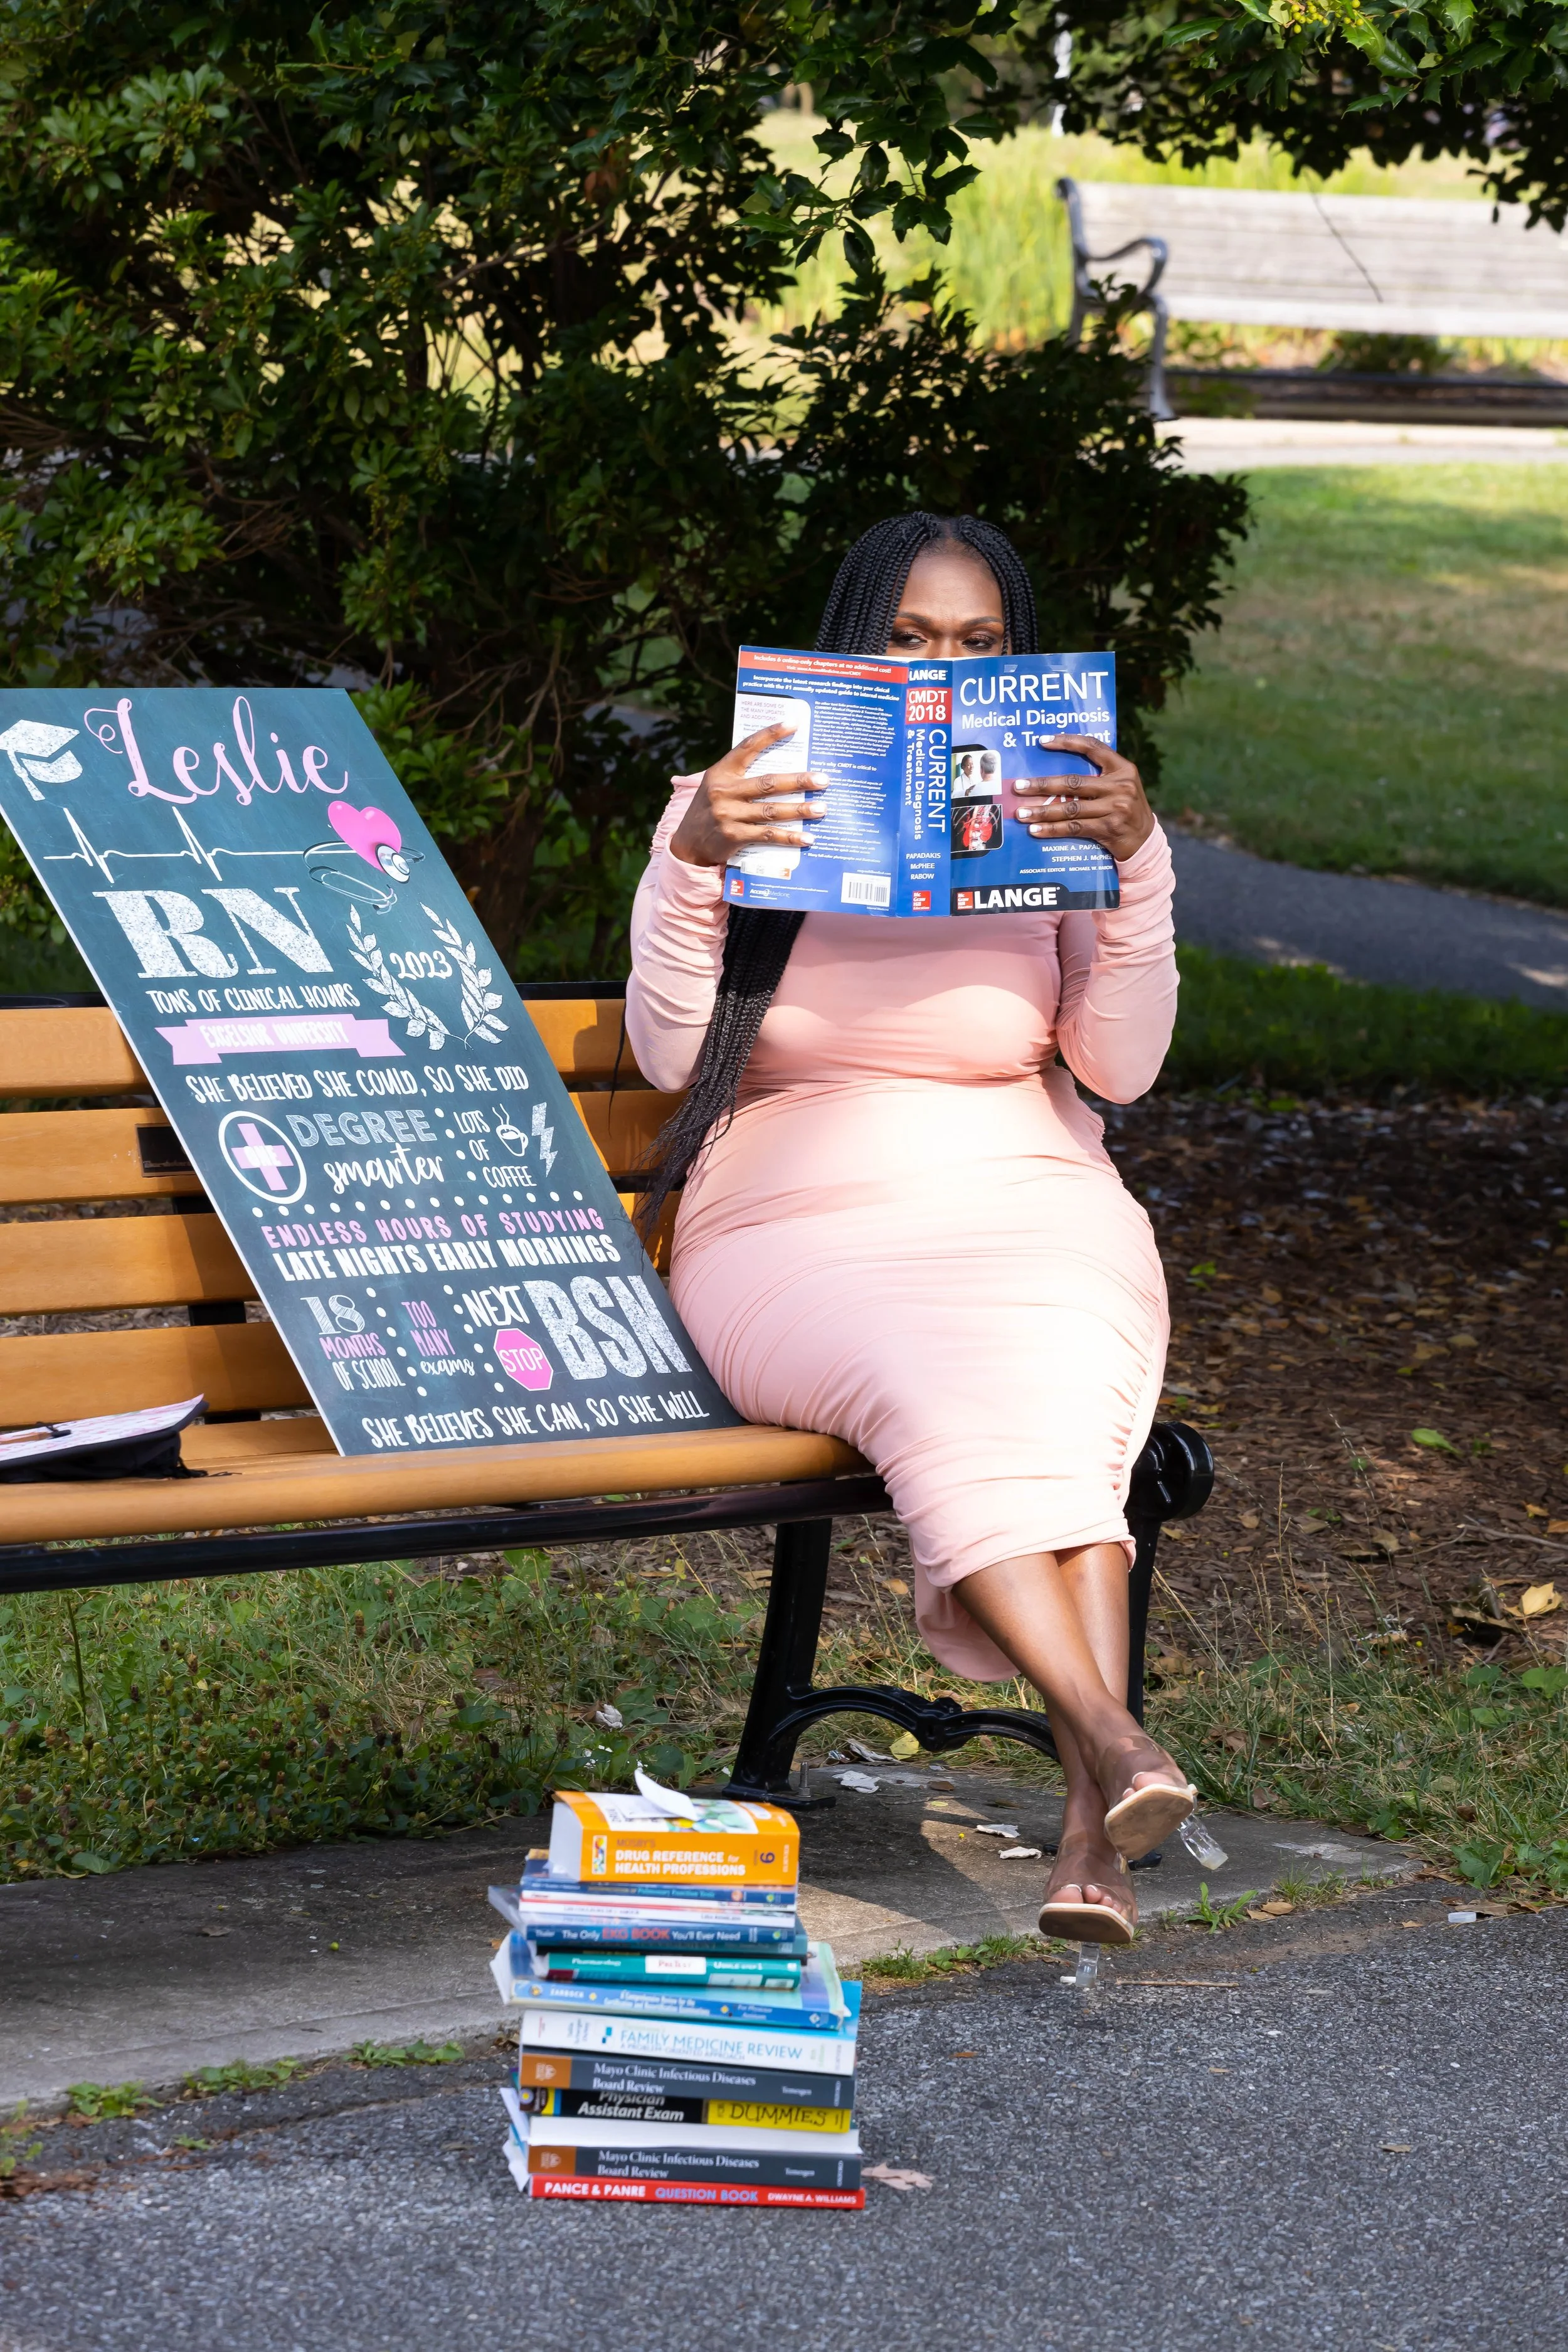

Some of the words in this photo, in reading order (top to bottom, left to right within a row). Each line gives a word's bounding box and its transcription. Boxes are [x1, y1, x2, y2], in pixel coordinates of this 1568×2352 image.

[909, 669, 946, 681] LANGE
[960, 671, 1109, 706] CURRENT
[908, 690, 948, 704] CMDT
[908, 704, 946, 721] 2018
[962, 709, 1020, 729] Medical
[1026, 707, 1110, 728] Diagnosis
[907, 729, 915, 739] &
[1003, 732, 1017, 748] &
[84, 696, 348, 805] Leslie
[915, 729, 926, 776] Medical
[905, 743, 914, 806] Treatment
[928, 729, 946, 833] CURRENT
[913, 781, 925, 840] Diagnosis
[975, 886, 1057, 909] LANGE
[93, 887, 334, 979] RN
[389, 950, 453, 980] 2023
[146, 988, 197, 1014] TONS
[198, 988, 221, 1012] OF
[224, 985, 304, 1012] CLINICAL
[299, 983, 361, 1009] HOURS
[199, 1023, 275, 1049] EXCELSIOR
[272, 1020, 349, 1046] UNIVERSITY
[185, 1075, 231, 1104] SHE
[226, 1072, 312, 1101] BELIEVED
[314, 1069, 359, 1098] SHE
[356, 1067, 427, 1097] COULD,
[423, 1065, 455, 1093] SO
[455, 1064, 497, 1092] SHE
[494, 1066, 529, 1091] DID
[285, 1110, 438, 1147] DEGREE
[453, 1110, 491, 1134] LOTS
[243, 1145, 282, 1167] ONE
[469, 1138, 490, 1161] OF
[324, 1142, 445, 1194] smarter
[482, 1165, 537, 1188] COFFEE
[261, 1220, 367, 1248] ENDLESS
[374, 1216, 452, 1242] HOURS
[460, 1214, 488, 1237] OF
[499, 1207, 605, 1235] STUDYING
[272, 1250, 337, 1281] LATE
[333, 1244, 428, 1278] NIGHTS
[425, 1240, 498, 1271] EARLY
[496, 1234, 621, 1267] MORNINGS
[300, 1295, 365, 1335] 18
[401, 1300, 437, 1328] TOO
[462, 1285, 530, 1328] NEXT
[522, 1274, 693, 1380] BSN
[319, 1332, 386, 1360] MONTHS
[410, 1329, 456, 1357] MANY
[420, 1359, 475, 1376] exams
[499, 1347, 544, 1374] STOP
[332, 1361, 354, 1391] OF
[352, 1358, 406, 1389] SCHOOL
[361, 1417, 410, 1448] SHE
[403, 1407, 494, 1444] BELIEVES
[492, 1405, 538, 1436] SHE
[535, 1401, 590, 1432] CAN,
[586, 1397, 619, 1428] SO
[618, 1394, 663, 1424] SHE
[659, 1390, 710, 1419] WILL
[615, 1850, 650, 1861] DRUG
[653, 1850, 724, 1863] REFERENCE
[728, 1855, 739, 1863] for
[615, 1862, 659, 1874] HEALTH
[662, 1863, 746, 1876] PROFESSIONS
[562, 1929, 578, 1939] The
[580, 1930, 600, 1941] Only
[602, 1928, 628, 1939] EKG
[631, 1929, 670, 1940] BOOK
[671, 1931, 694, 1941] You'll
[696, 1931, 715, 1941] Ever
[716, 1931, 741, 1941] Need
[620, 2030, 669, 2046] FAMILY
[673, 2036, 743, 2053] MEDICINE
[747, 2043, 803, 2059] REVIEW
[593, 2077, 624, 2090] Board
[627, 2079, 665, 2094] Review
[594, 2062, 623, 2078] Mayo
[625, 2064, 657, 2079] Clinic
[659, 2067, 711, 2082] Infectious
[712, 2071, 756, 2085] Diseases
[578, 2101, 642, 2119] Assistant
[644, 2106, 684, 2122] Exam
[731, 2102, 827, 2127] DUMMIES
[598, 2150, 628, 2164] Mayo
[629, 2151, 661, 2164] Clinic
[663, 2153, 714, 2166] Infectious
[716, 2155, 760, 2168] Diseases
[598, 2164, 628, 2177] Board
[631, 2167, 669, 2178] Review
[544, 2181, 589, 2195] PANCE
[591, 2183, 601, 2196] &
[604, 2185, 646, 2197] PANRE
[655, 2187, 716, 2200] QUESTION
[720, 2190, 758, 2202] BOOK
[768, 2192, 805, 2203] DWAYNE
[815, 2194, 857, 2204] WILLIAMS
